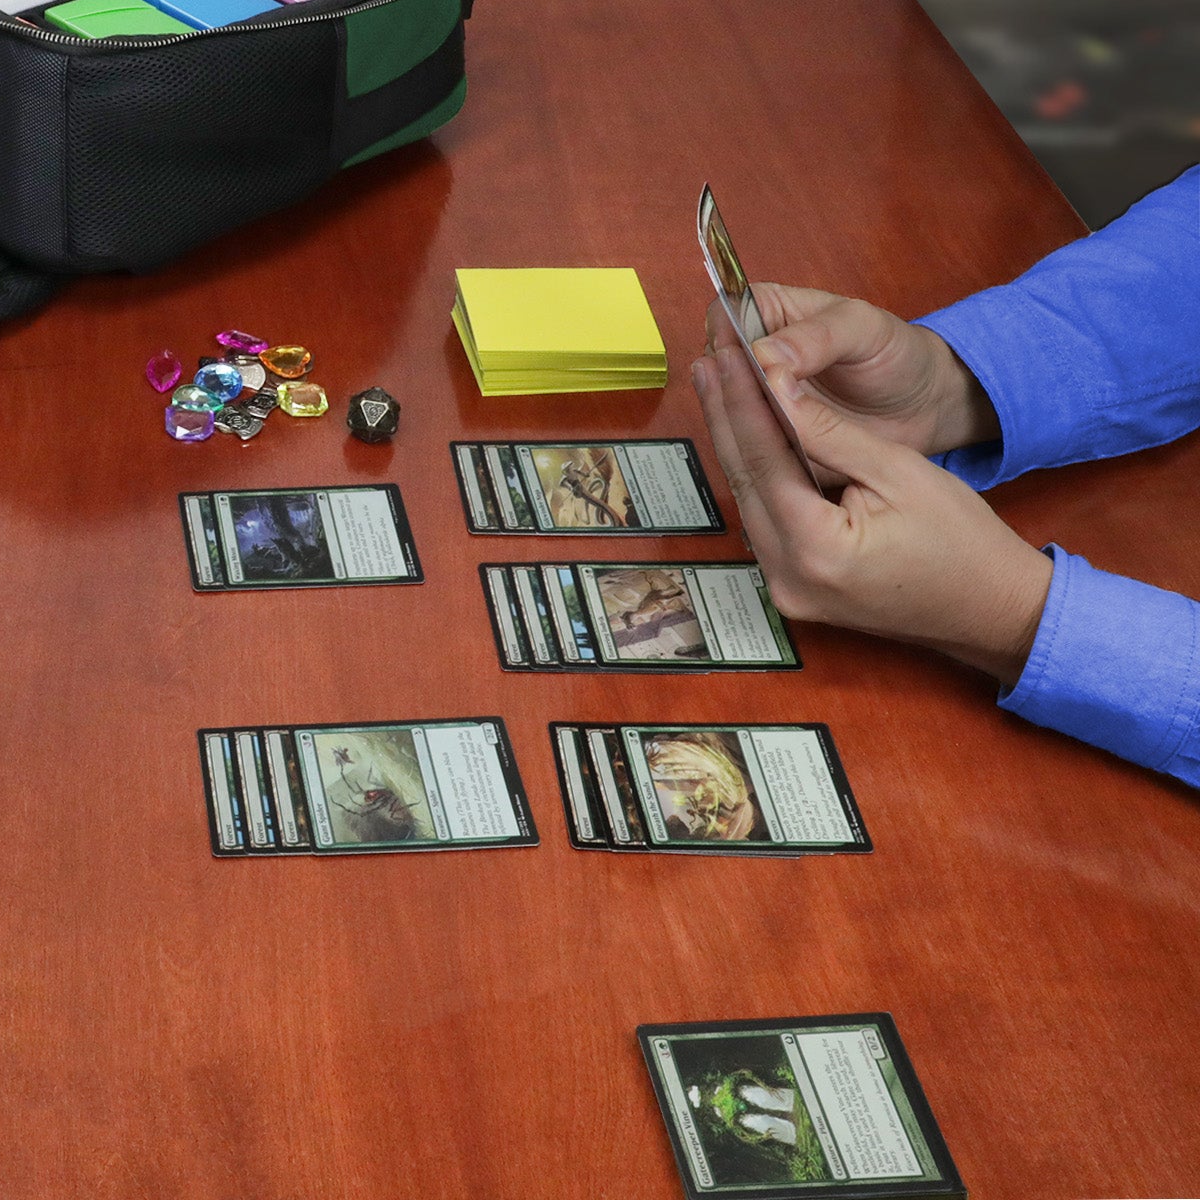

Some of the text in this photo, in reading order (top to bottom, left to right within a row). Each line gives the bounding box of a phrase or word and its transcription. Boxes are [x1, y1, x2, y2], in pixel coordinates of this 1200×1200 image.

[477, 510, 486, 524] Forest
[203, 565, 211, 581] Forest
[509, 643, 520, 660] Forest
[537, 642, 548, 659] Forest
[566, 641, 577, 657] Forest
[641, 781, 665, 838] Beneath the Sands
[255, 821, 265, 841] Forest
[286, 820, 296, 840] Forest
[315, 802, 330, 842] Giant Spider
[581, 817, 591, 836] Forest
[616, 819, 627, 839] Forest
[224, 824, 233, 843] Forest
[865, 1035, 880, 1050] 0/2
[680, 1110, 713, 1184] Gatecreeper Vine
[814, 1115, 843, 1176] Creature Plant
